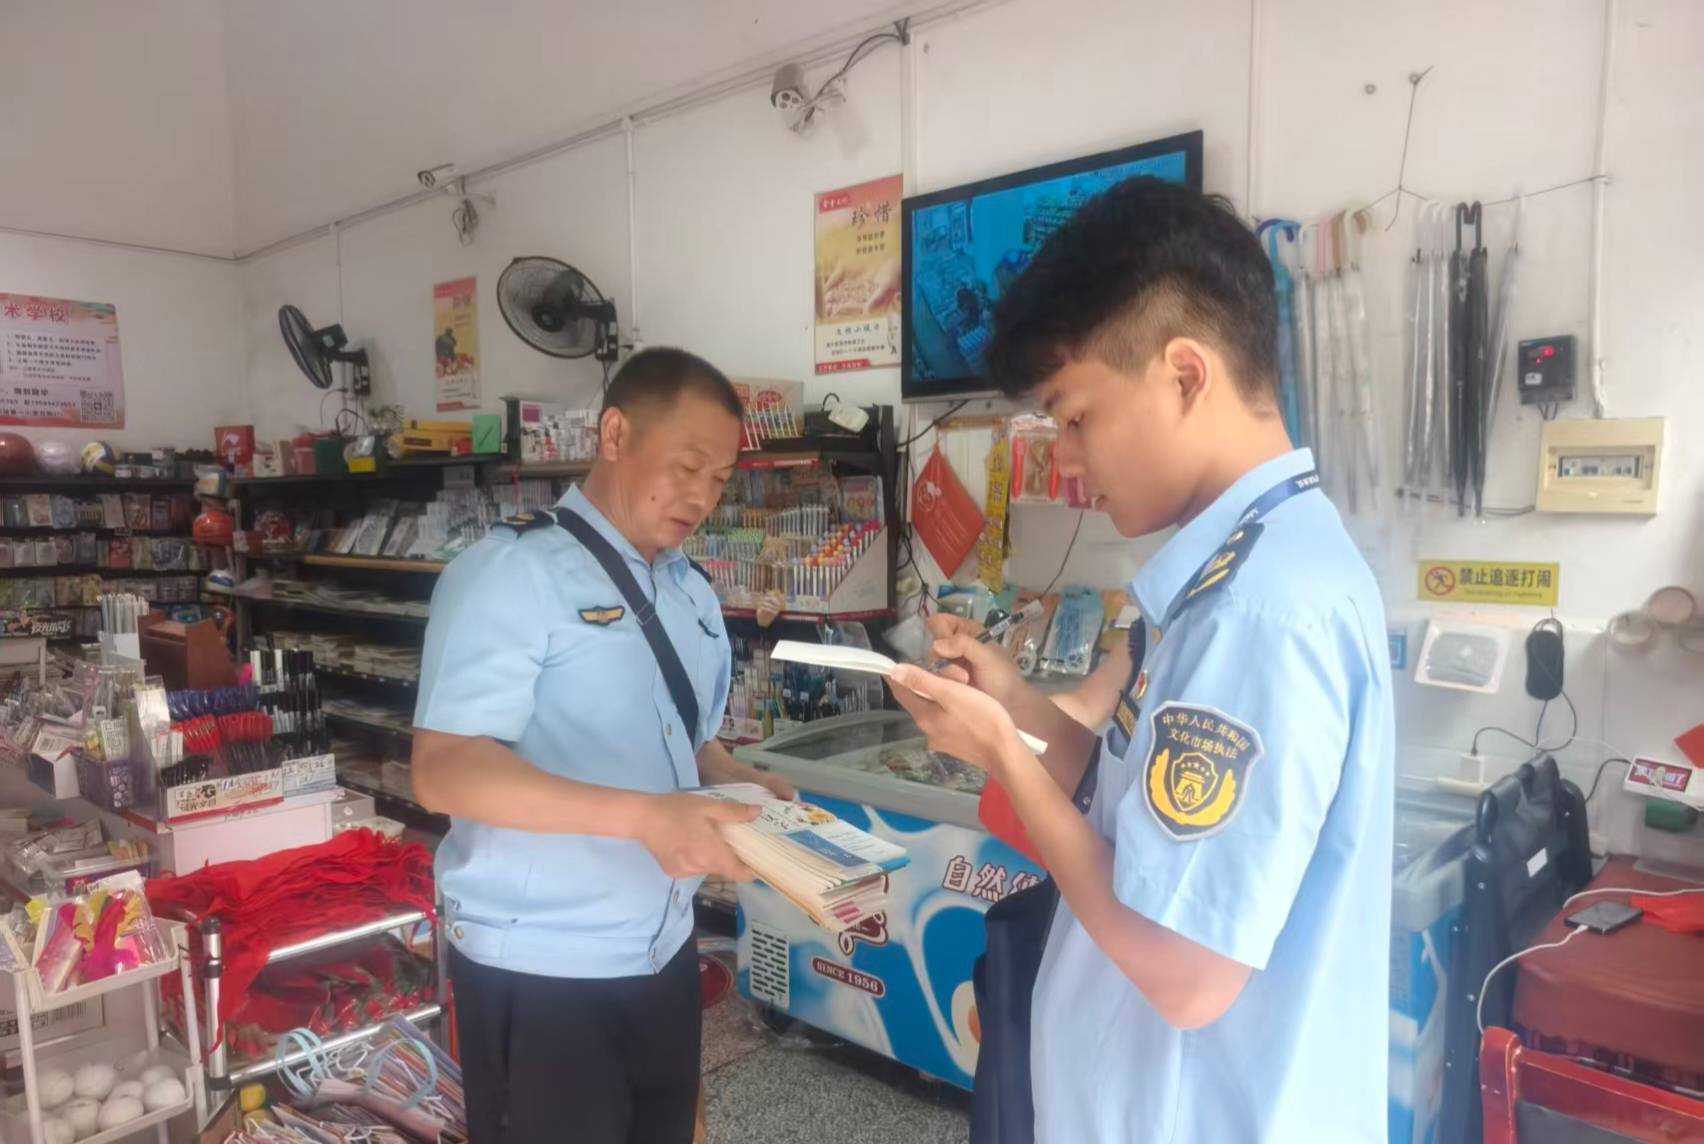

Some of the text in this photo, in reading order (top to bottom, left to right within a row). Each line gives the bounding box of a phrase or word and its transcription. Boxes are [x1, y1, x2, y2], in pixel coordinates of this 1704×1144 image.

[852, 201, 892, 227] 珍惜
[1459, 567, 1551, 588] 禁止追逐打闹
[1162, 711, 1250, 751] 中华人民共和国
[1167, 727, 1239, 760] 文化市场执法
[816, 960, 879, 993] SINCE 1956
